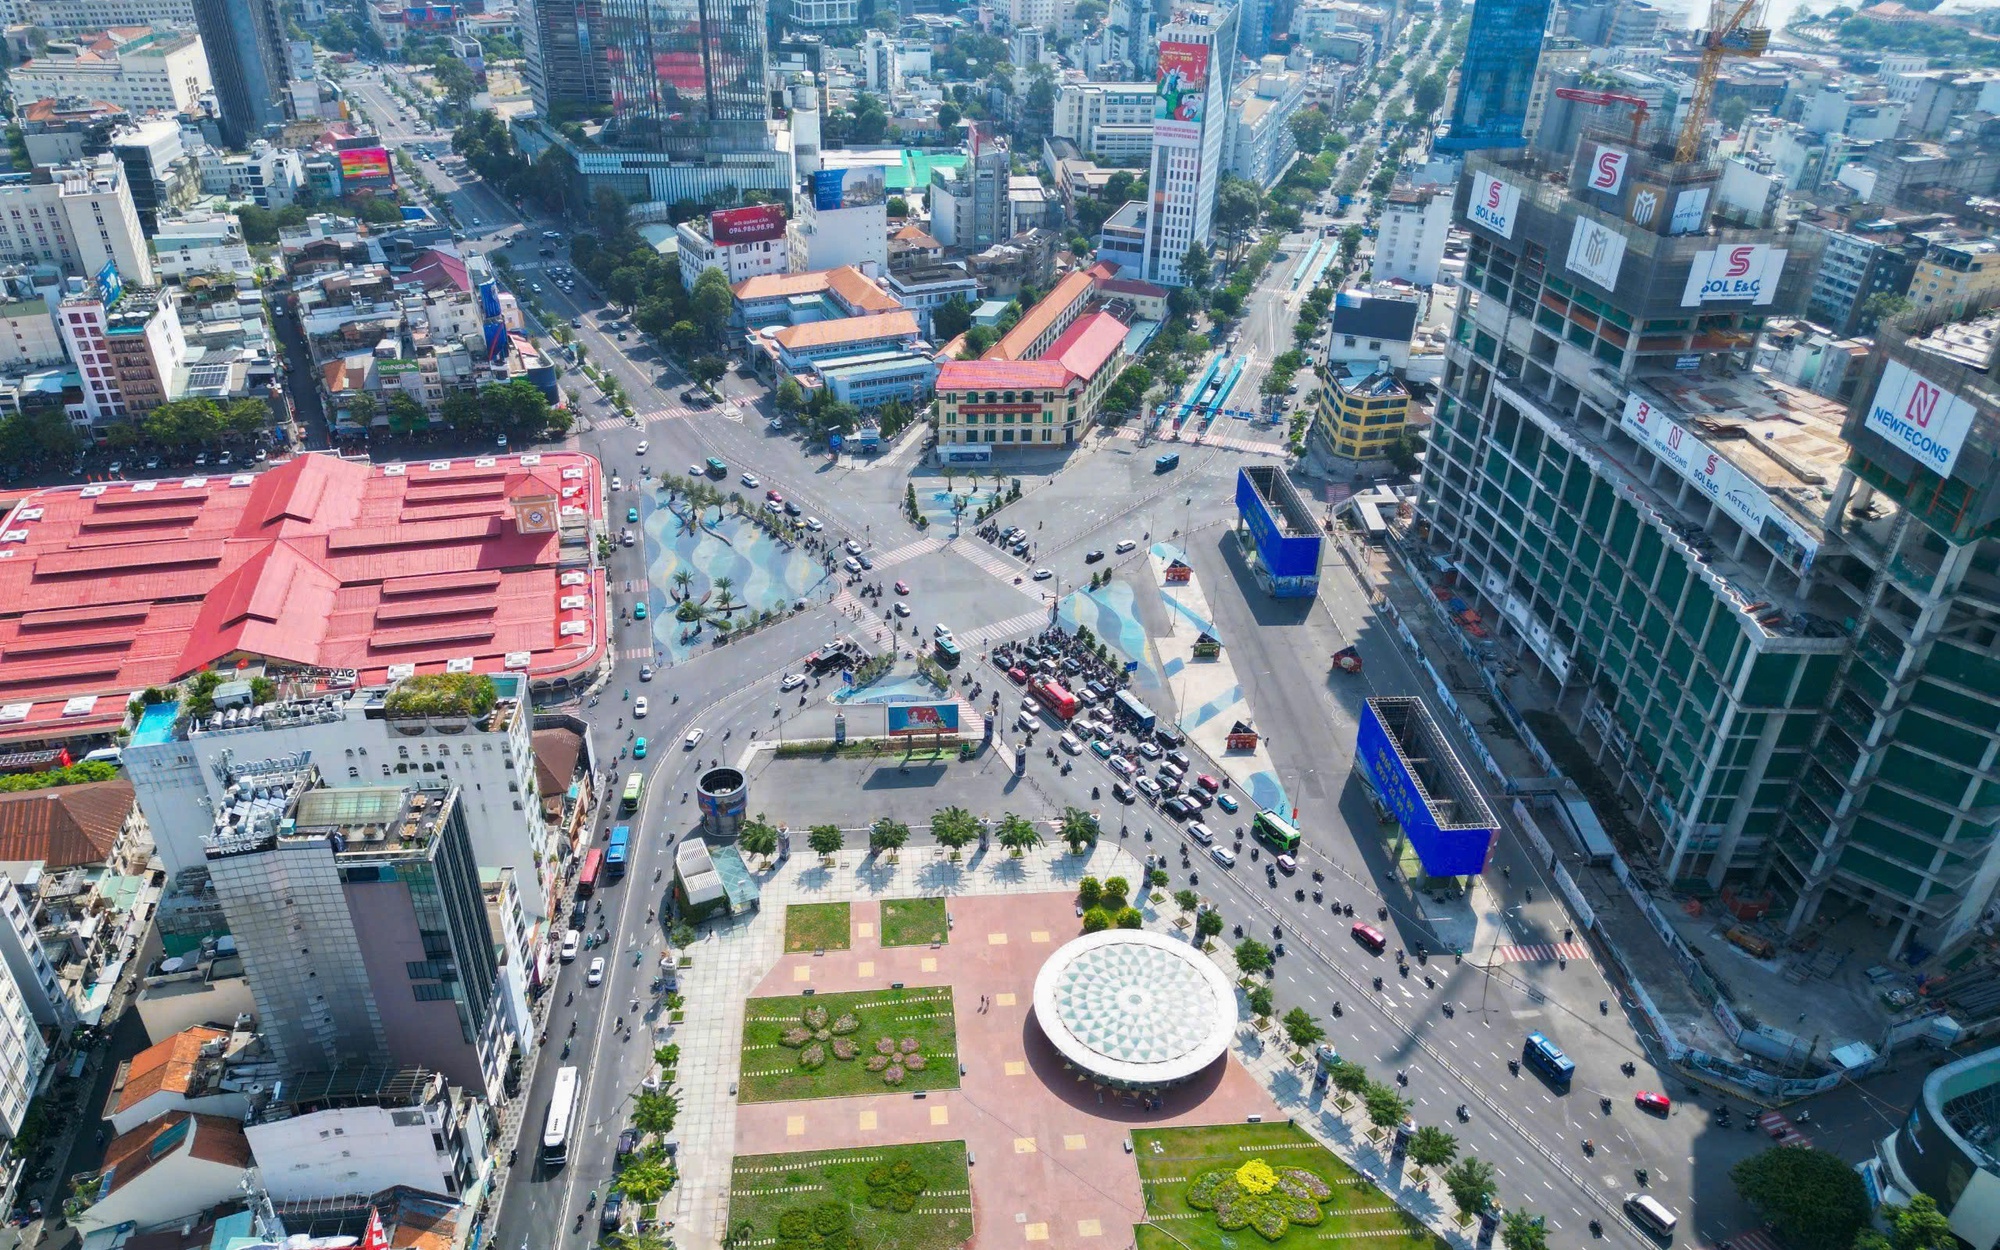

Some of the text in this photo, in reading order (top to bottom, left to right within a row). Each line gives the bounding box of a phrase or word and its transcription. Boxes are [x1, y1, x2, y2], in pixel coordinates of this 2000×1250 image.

[1188, 13, 1209, 26] MB
[1475, 205, 1489, 221] SOL
[1491, 212, 1506, 228] E&C
[1701, 279, 1760, 293] SOL E&C
[1873, 406, 1949, 463] NEWTECONS
[1653, 438, 1688, 469] NEWTECONS
[1693, 469, 1706, 484] SOL
[1706, 480, 1719, 494] E&C
[1725, 491, 1760, 525] ARTELIA
